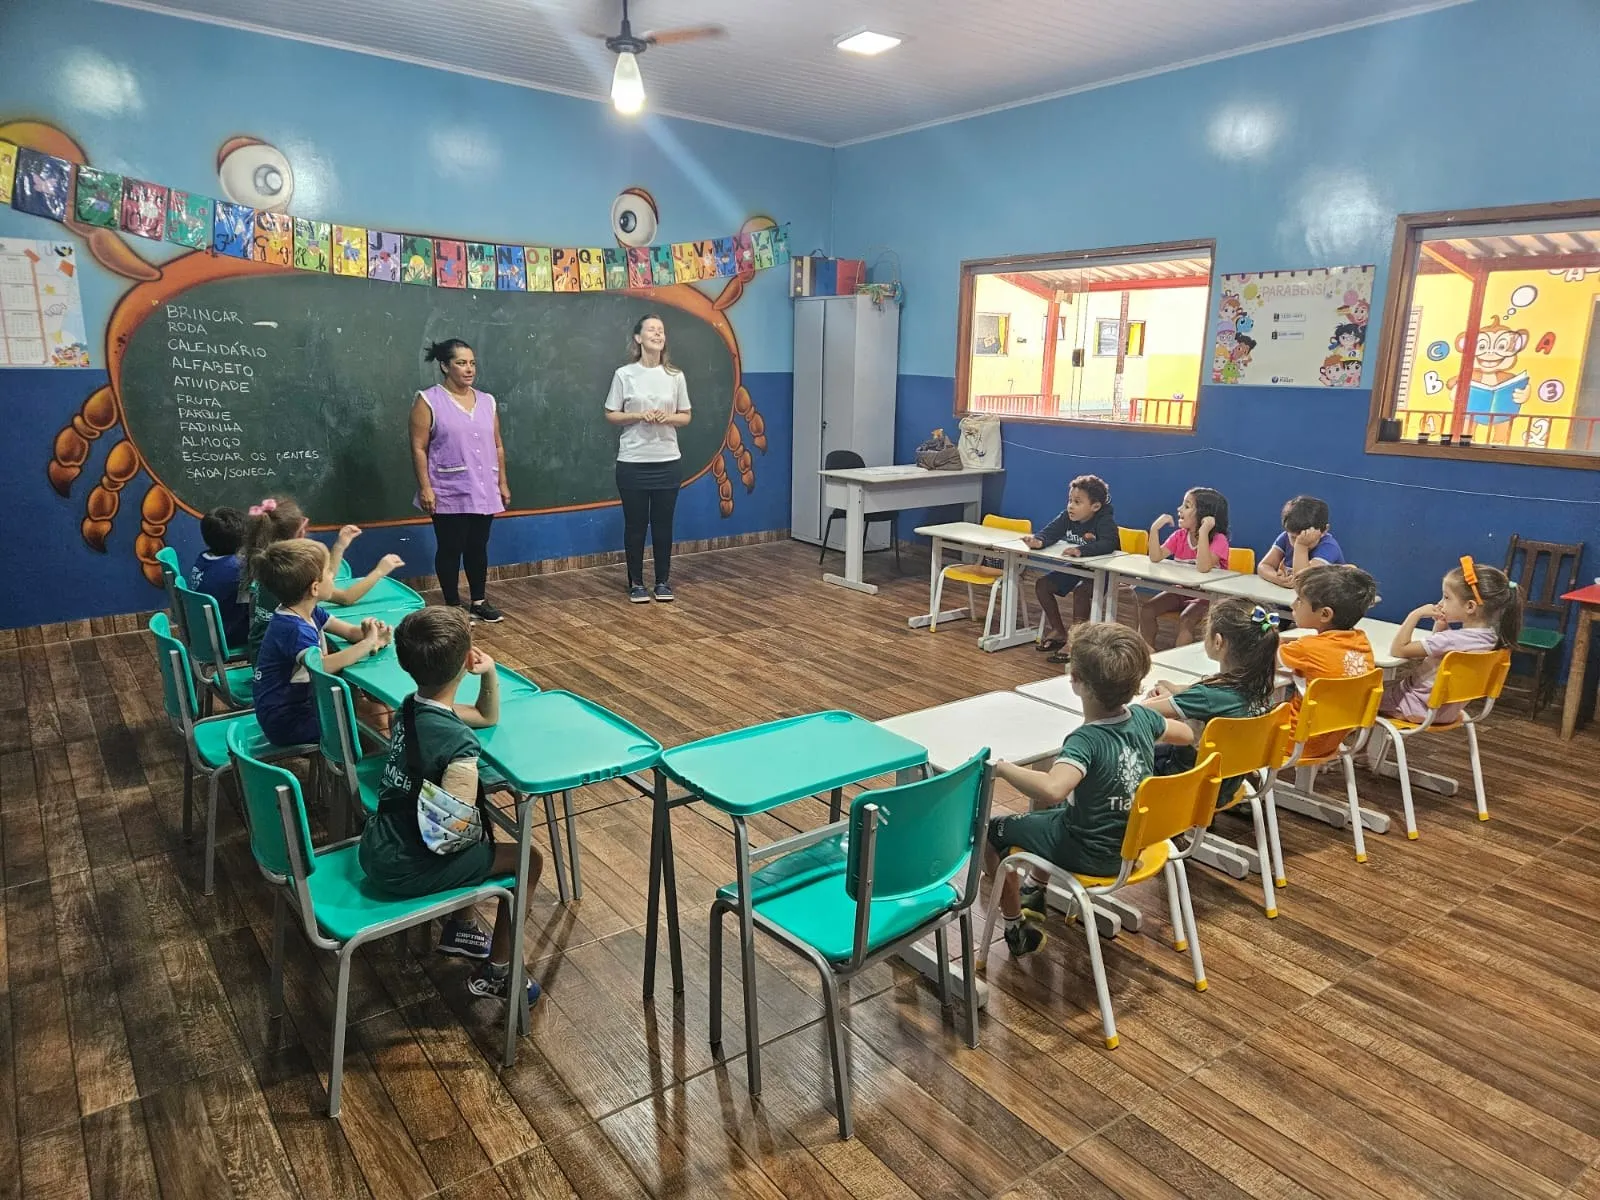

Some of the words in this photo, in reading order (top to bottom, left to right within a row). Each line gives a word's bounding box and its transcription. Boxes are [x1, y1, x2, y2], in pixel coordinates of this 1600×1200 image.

[498, 247, 512, 264] N
[553, 249, 564, 265] P
[579, 249, 591, 264] Q
[604, 249, 615, 264] R
[629, 248, 639, 264] S
[649, 247, 660, 262] T
[693, 242, 704, 257] V
[166, 305, 243, 324] BRINCAR
[168, 321, 208, 335] RODA
[168, 338, 267, 358] CALENDÁRIO
[1535, 331, 1556, 355] A
[172, 356, 253, 377] ALFABETO
[174, 375, 250, 393] ATIVIDADE
[1424, 370, 1444, 396] B
[177, 394, 222, 408] FRUTA
[178, 408, 231, 421] PARQUE
[180, 422, 243, 433] FADINHA
[182, 435, 240, 449] ALMOÇO
[182, 451, 244, 462] ESCOVAR
[251, 452, 266, 461] OS
[1107, 796, 1132, 811] Tia
